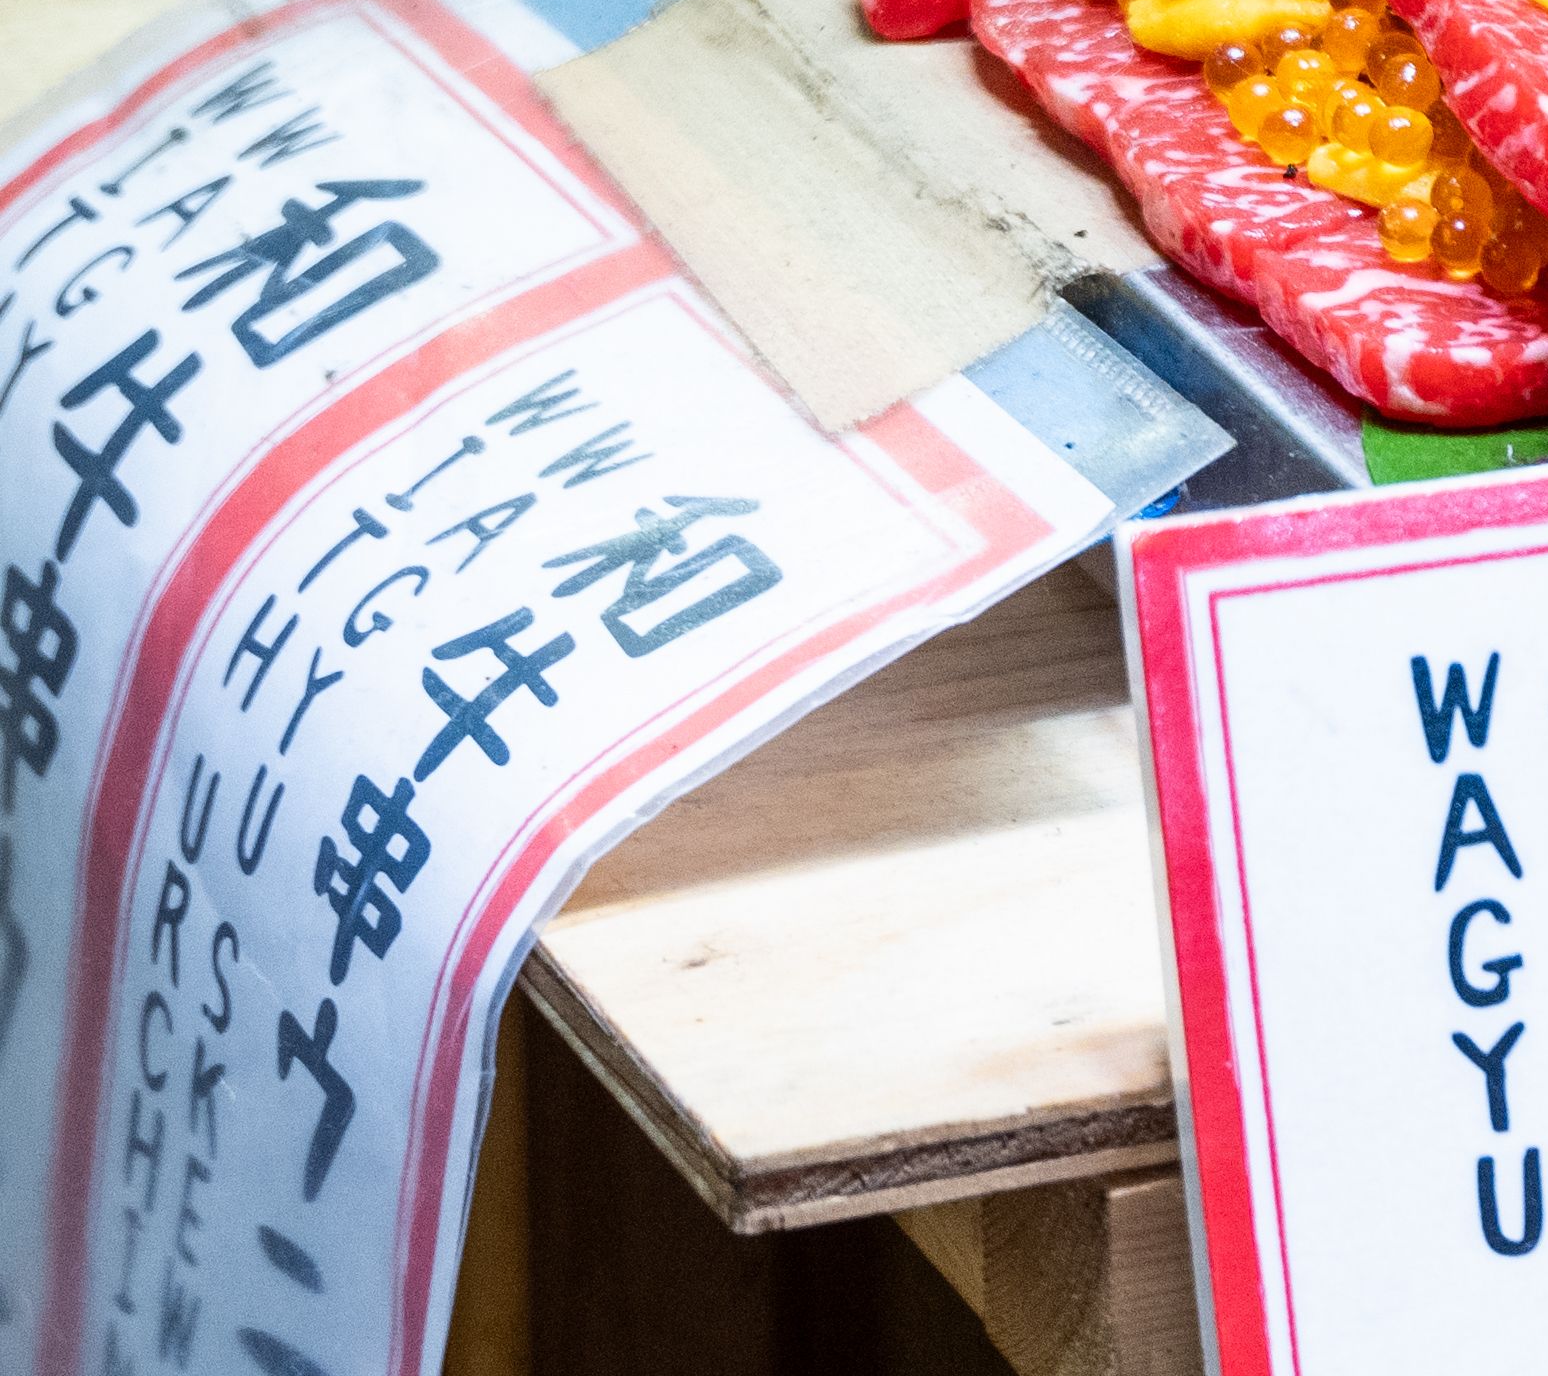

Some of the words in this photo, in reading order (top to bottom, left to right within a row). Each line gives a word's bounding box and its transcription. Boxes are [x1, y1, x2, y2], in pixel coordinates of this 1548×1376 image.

[0, 59, 294, 324] WIT
[222, 367, 587, 713] WITH
[236, 422, 653, 876] WAGYU
[1409, 650, 1545, 1258] WAGYU
